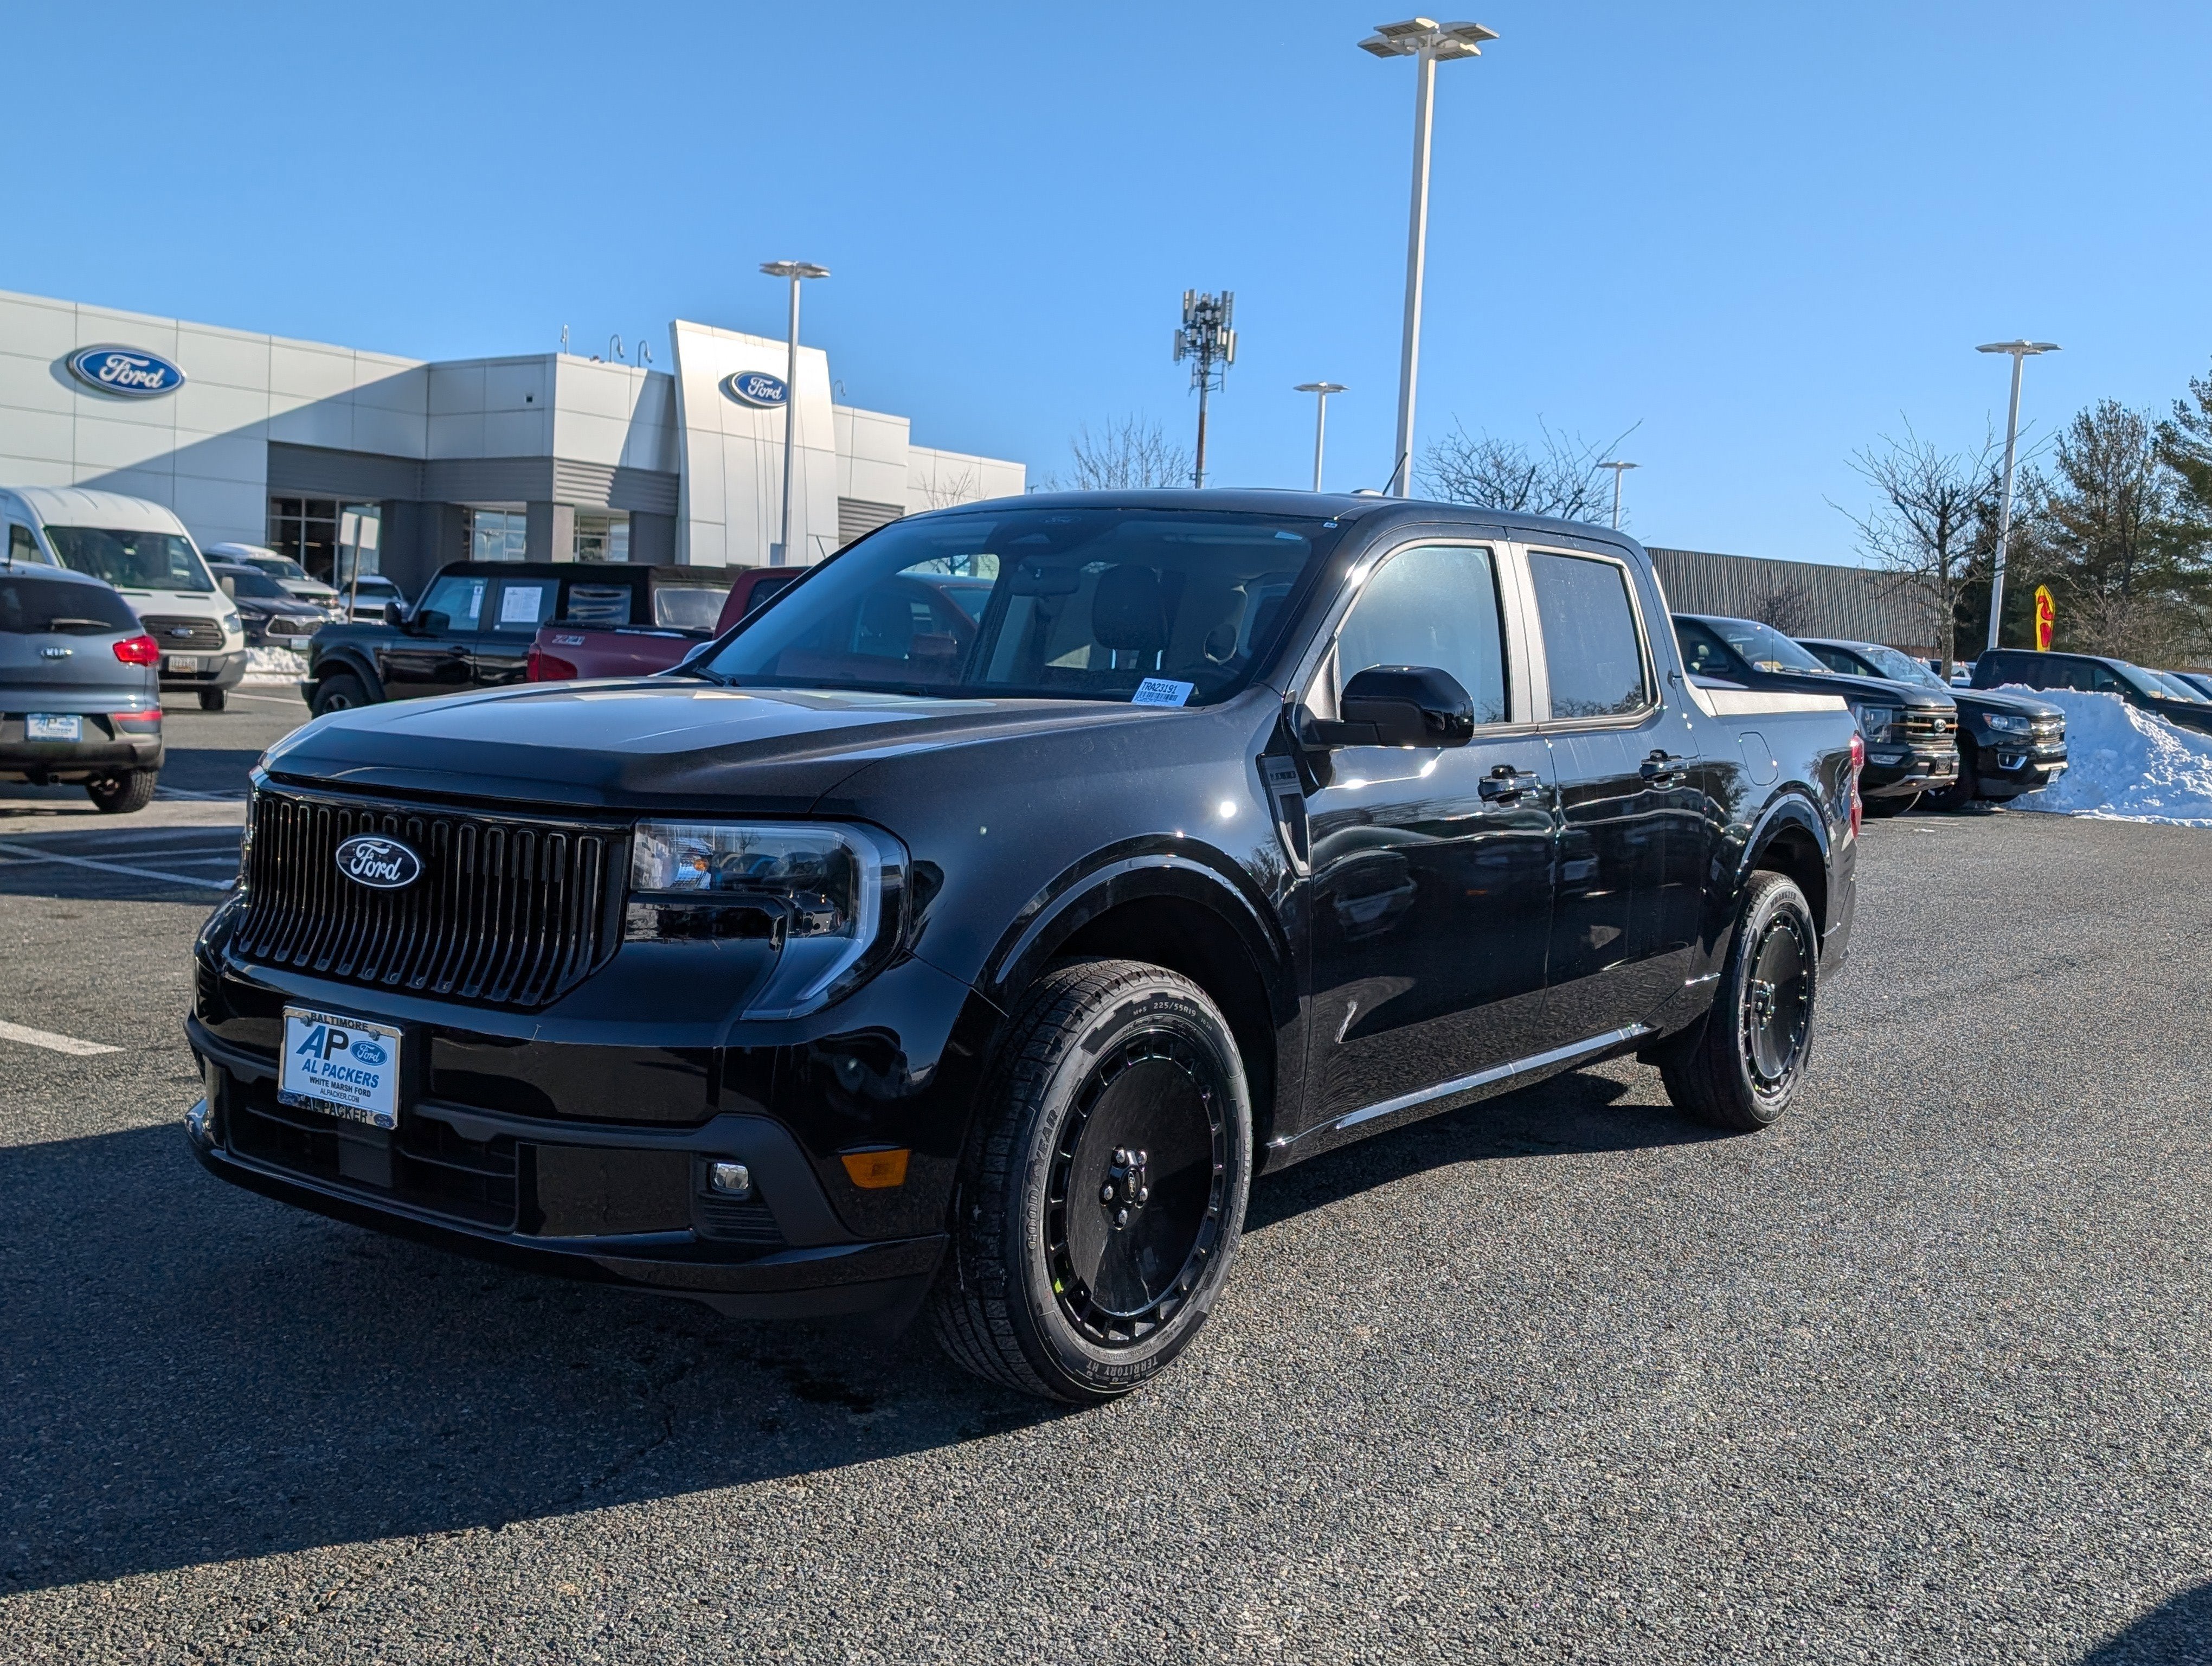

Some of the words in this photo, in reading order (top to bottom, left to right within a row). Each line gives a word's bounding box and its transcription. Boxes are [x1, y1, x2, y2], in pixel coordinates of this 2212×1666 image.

[99, 354, 165, 388] Ford
[748, 377, 782, 400] Ford
[1141, 681, 1178, 694] TRA23191
[350, 843, 402, 881] Ford
[1153, 1002, 1197, 1017] 225/55R19
[311, 1012, 369, 1032] BALTIMORE
[295, 1025, 349, 1061] AP
[357, 1044, 380, 1062] Ford
[301, 1058, 318, 1074] AL
[321, 1062, 379, 1088] PACKERS
[309, 1076, 330, 1087] WHITE
[331, 1081, 352, 1093] MARSH
[355, 1087, 371, 1097] FORD
[320, 1088, 359, 1103] ALPACKER.COM
[1086, 1360, 1099, 1373] HT
[1104, 1356, 1158, 1376] TERRITORY
